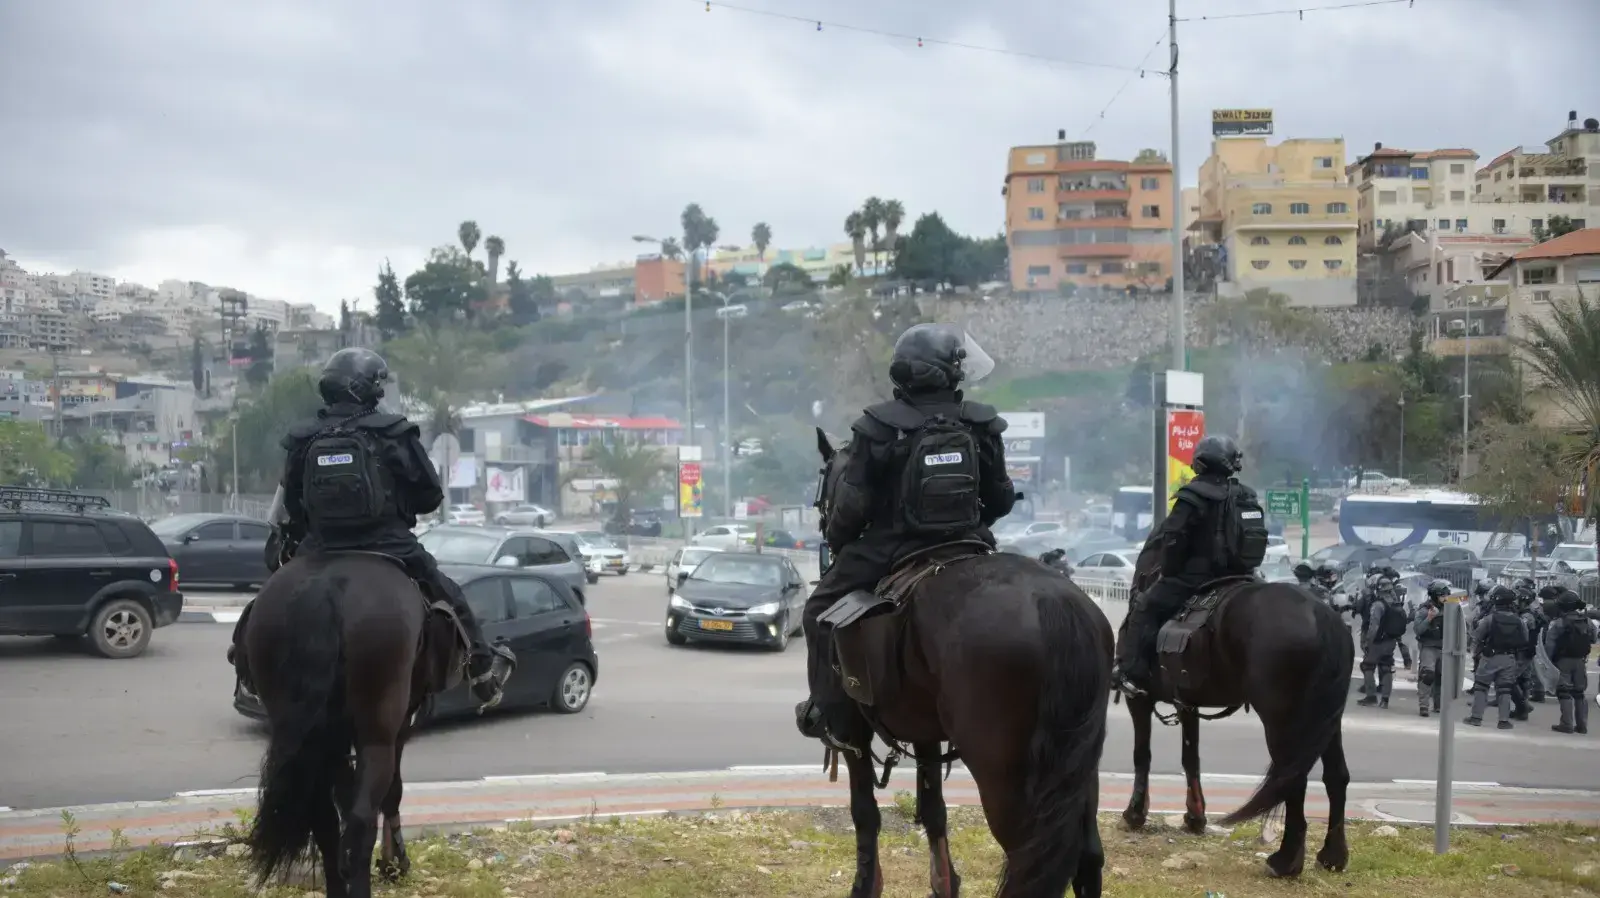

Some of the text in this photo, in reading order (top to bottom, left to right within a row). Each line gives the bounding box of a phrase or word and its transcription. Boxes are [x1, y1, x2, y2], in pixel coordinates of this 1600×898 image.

[1187, 425, 1199, 436] كل
[319, 455, 351, 464] משטרה
[927, 454, 960, 464] משטרה
